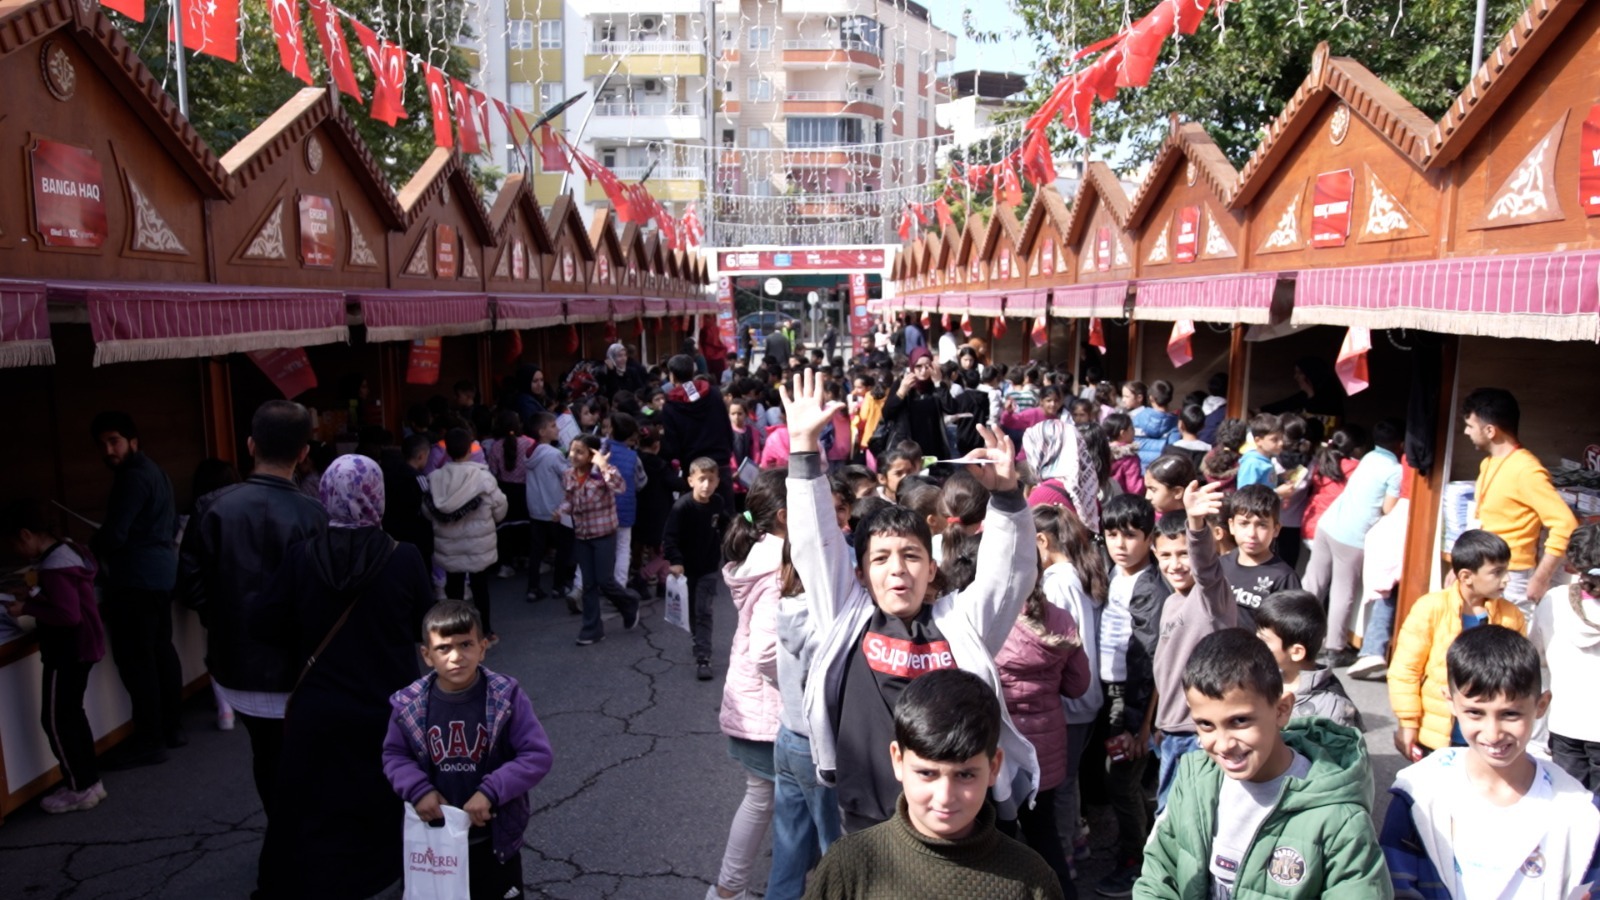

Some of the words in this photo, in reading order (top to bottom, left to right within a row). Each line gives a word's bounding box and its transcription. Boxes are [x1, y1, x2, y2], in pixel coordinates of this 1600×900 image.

[41, 177, 77, 197] BANGA
[78, 183, 100, 202] HAQ
[866, 638, 953, 671] Supreme
[427, 720, 491, 765] GAP
[439, 762, 477, 772] LONDON
